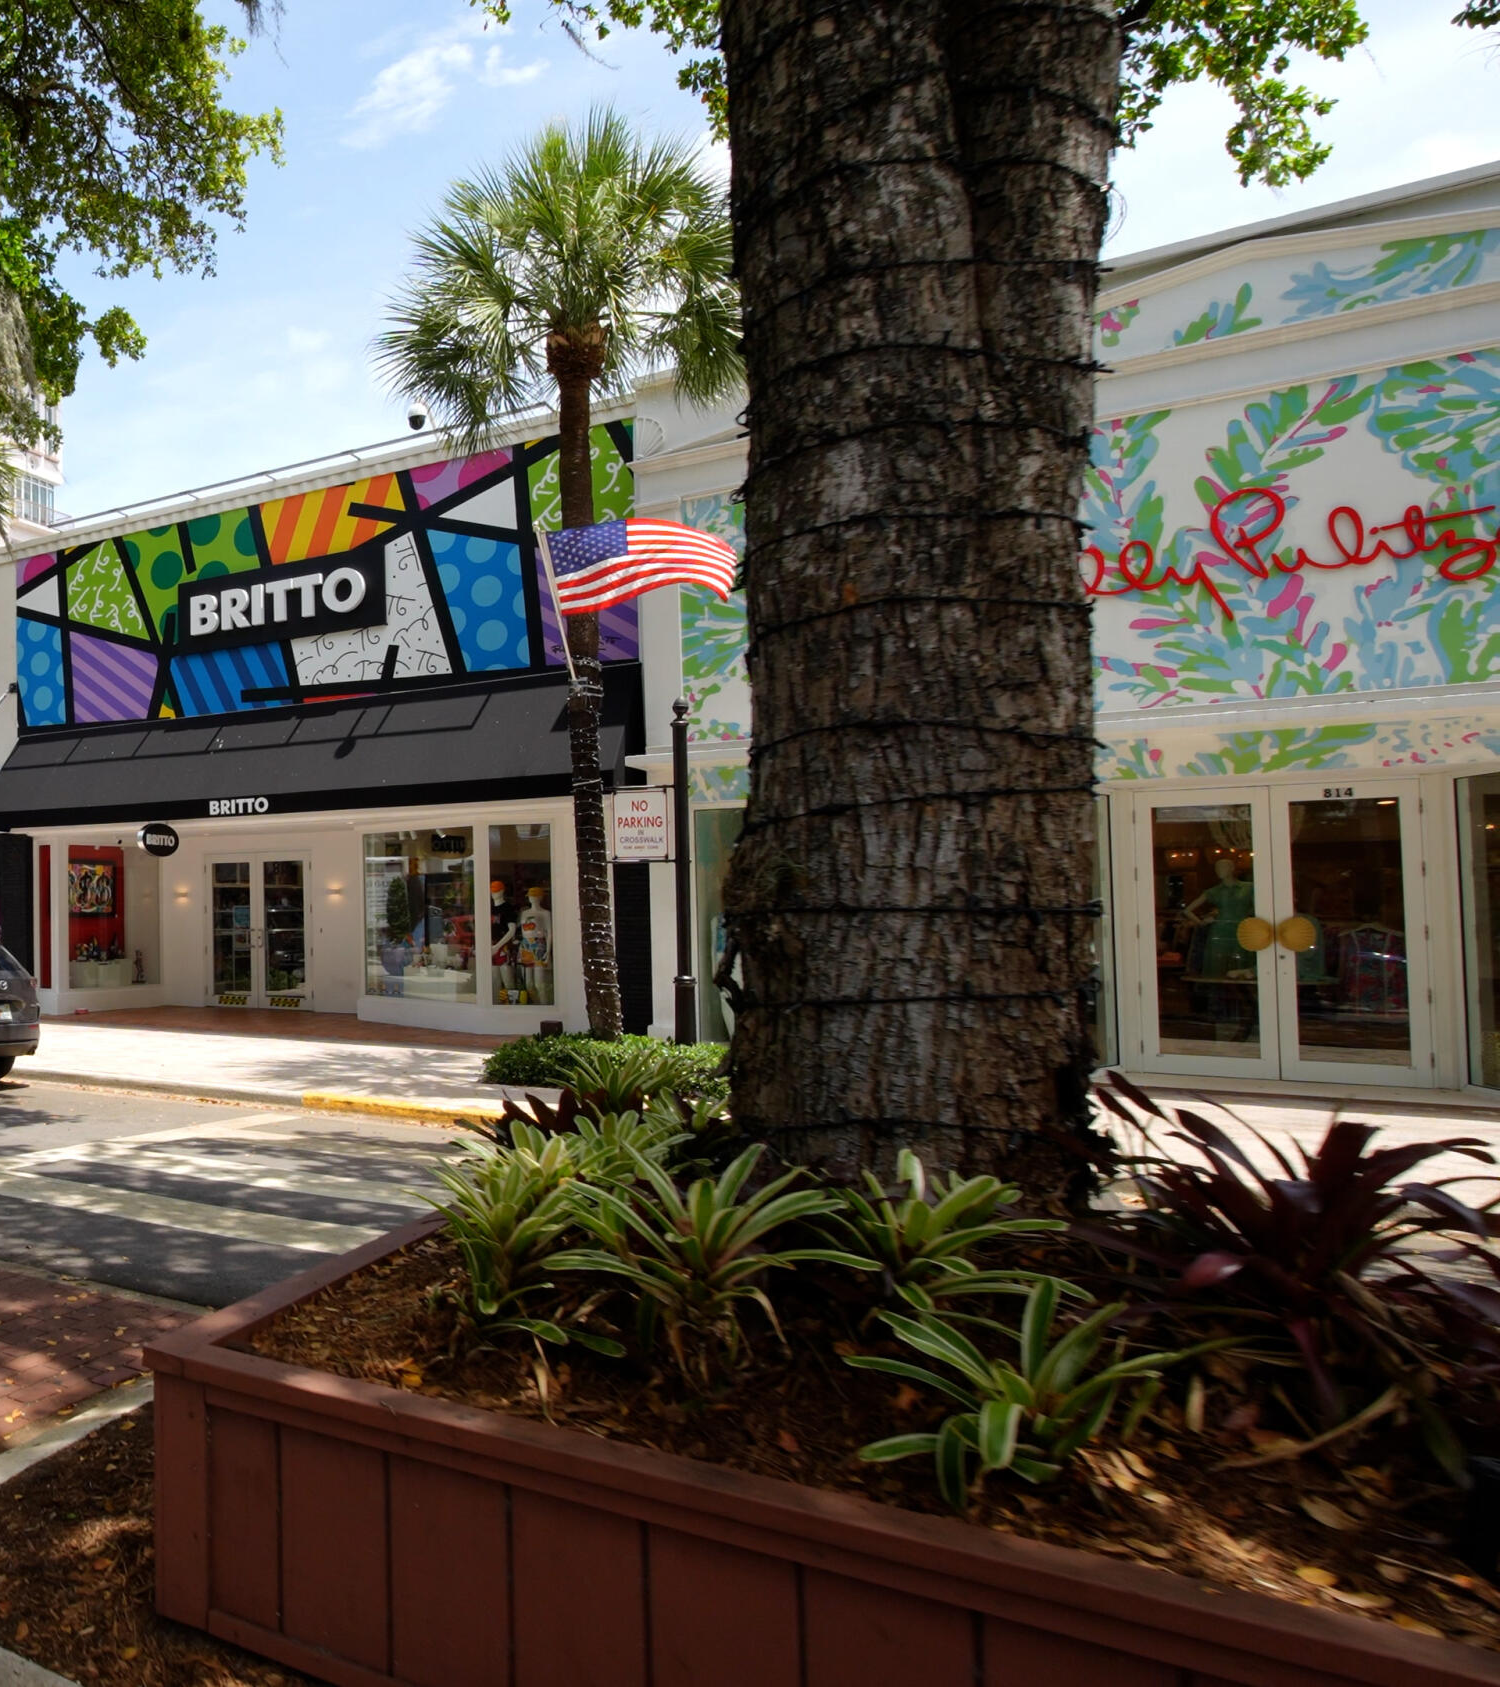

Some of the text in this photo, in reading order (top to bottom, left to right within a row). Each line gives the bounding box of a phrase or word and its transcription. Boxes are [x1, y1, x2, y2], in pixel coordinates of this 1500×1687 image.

[1078, 487, 1500, 622] lly Pulitz
[189, 566, 367, 637] BRITTO
[1323, 787, 1354, 798] 814
[209, 797, 269, 816] BRITTO
[631, 800, 649, 812] NO
[617, 816, 663, 828] PARKING
[146, 833, 176, 847] BRITTO
[619, 836, 664, 844] CROSSWALK
